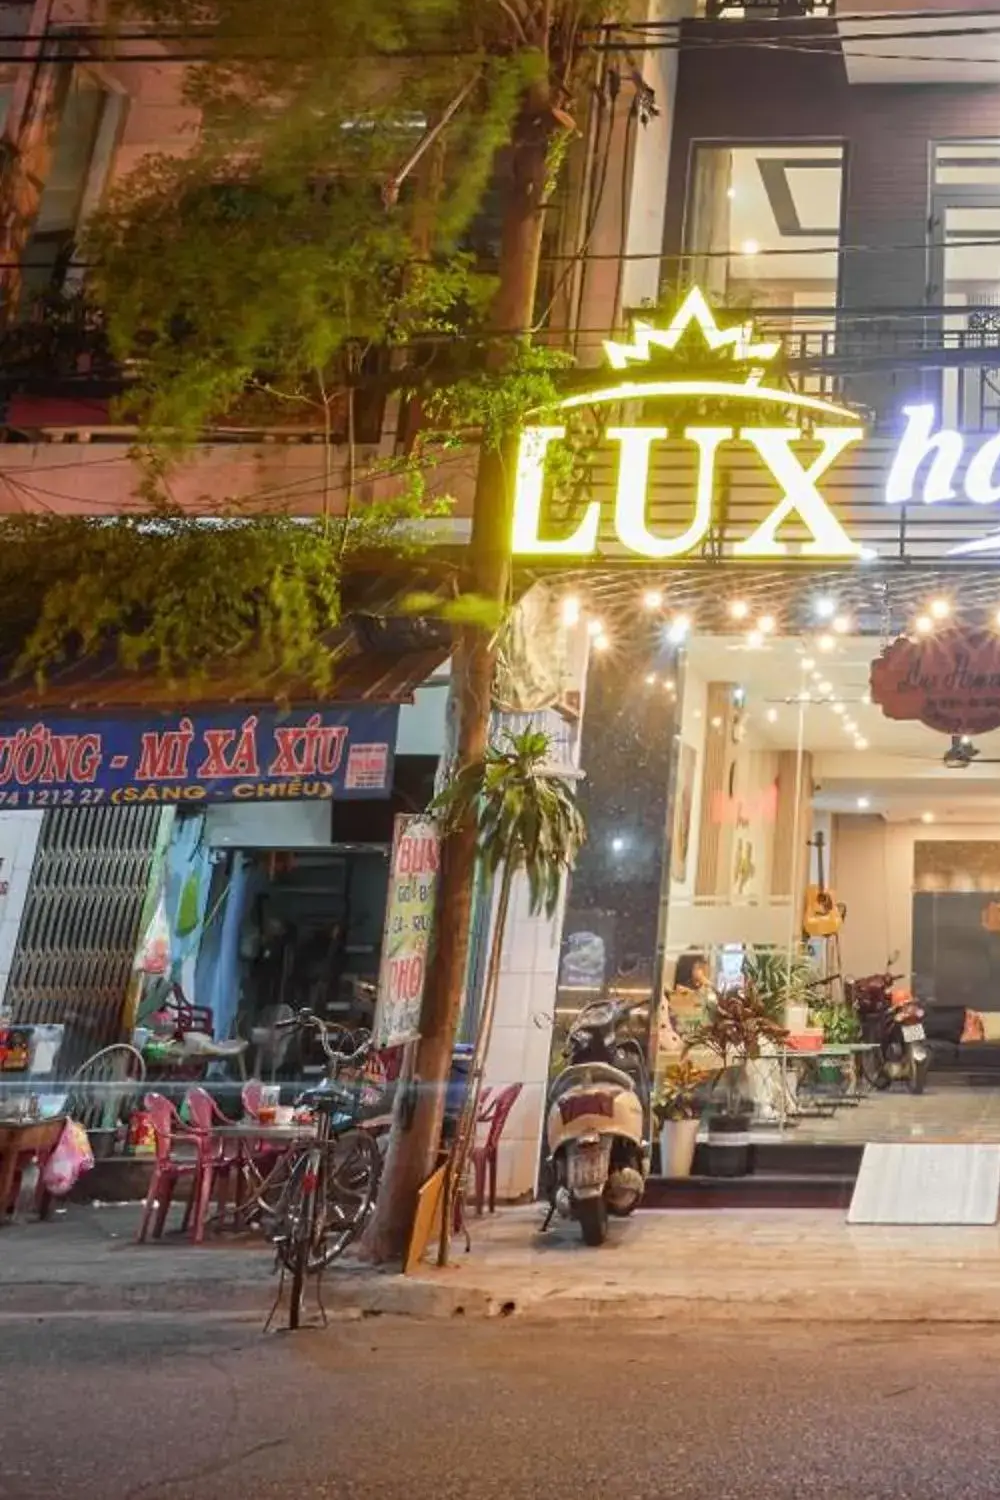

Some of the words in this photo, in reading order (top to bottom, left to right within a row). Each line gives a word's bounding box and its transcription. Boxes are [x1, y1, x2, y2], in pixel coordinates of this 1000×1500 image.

[511, 426, 866, 558] LUX
[197, 715, 261, 779] XÁ
[267, 713, 349, 777] XÍU
